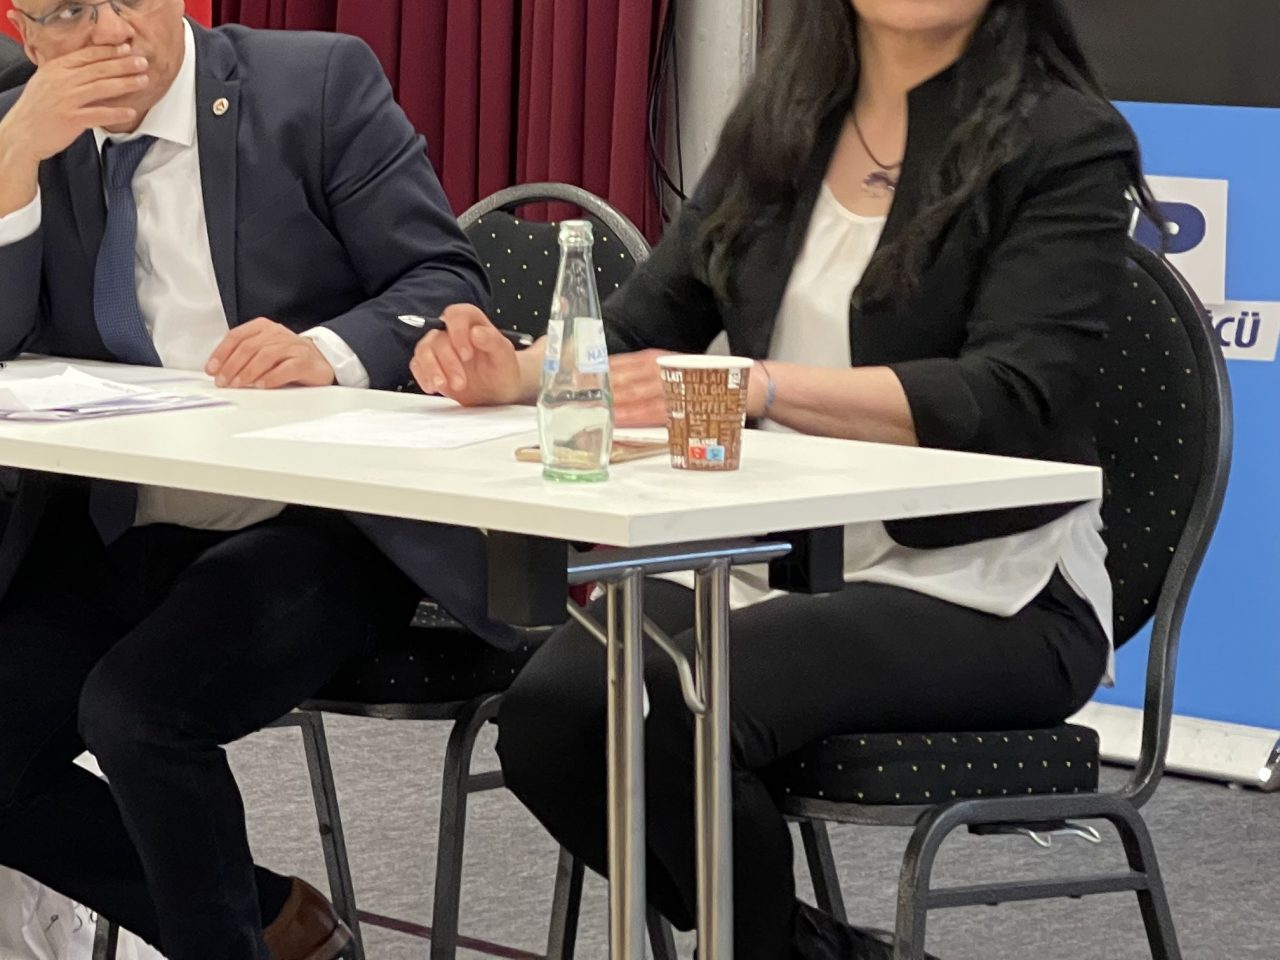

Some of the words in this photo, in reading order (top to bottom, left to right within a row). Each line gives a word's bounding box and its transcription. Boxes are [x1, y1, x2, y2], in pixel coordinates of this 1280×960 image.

[693, 384, 707, 394] TO
[710, 384, 725, 394] GO
[686, 401, 727, 414] KAFFEE
